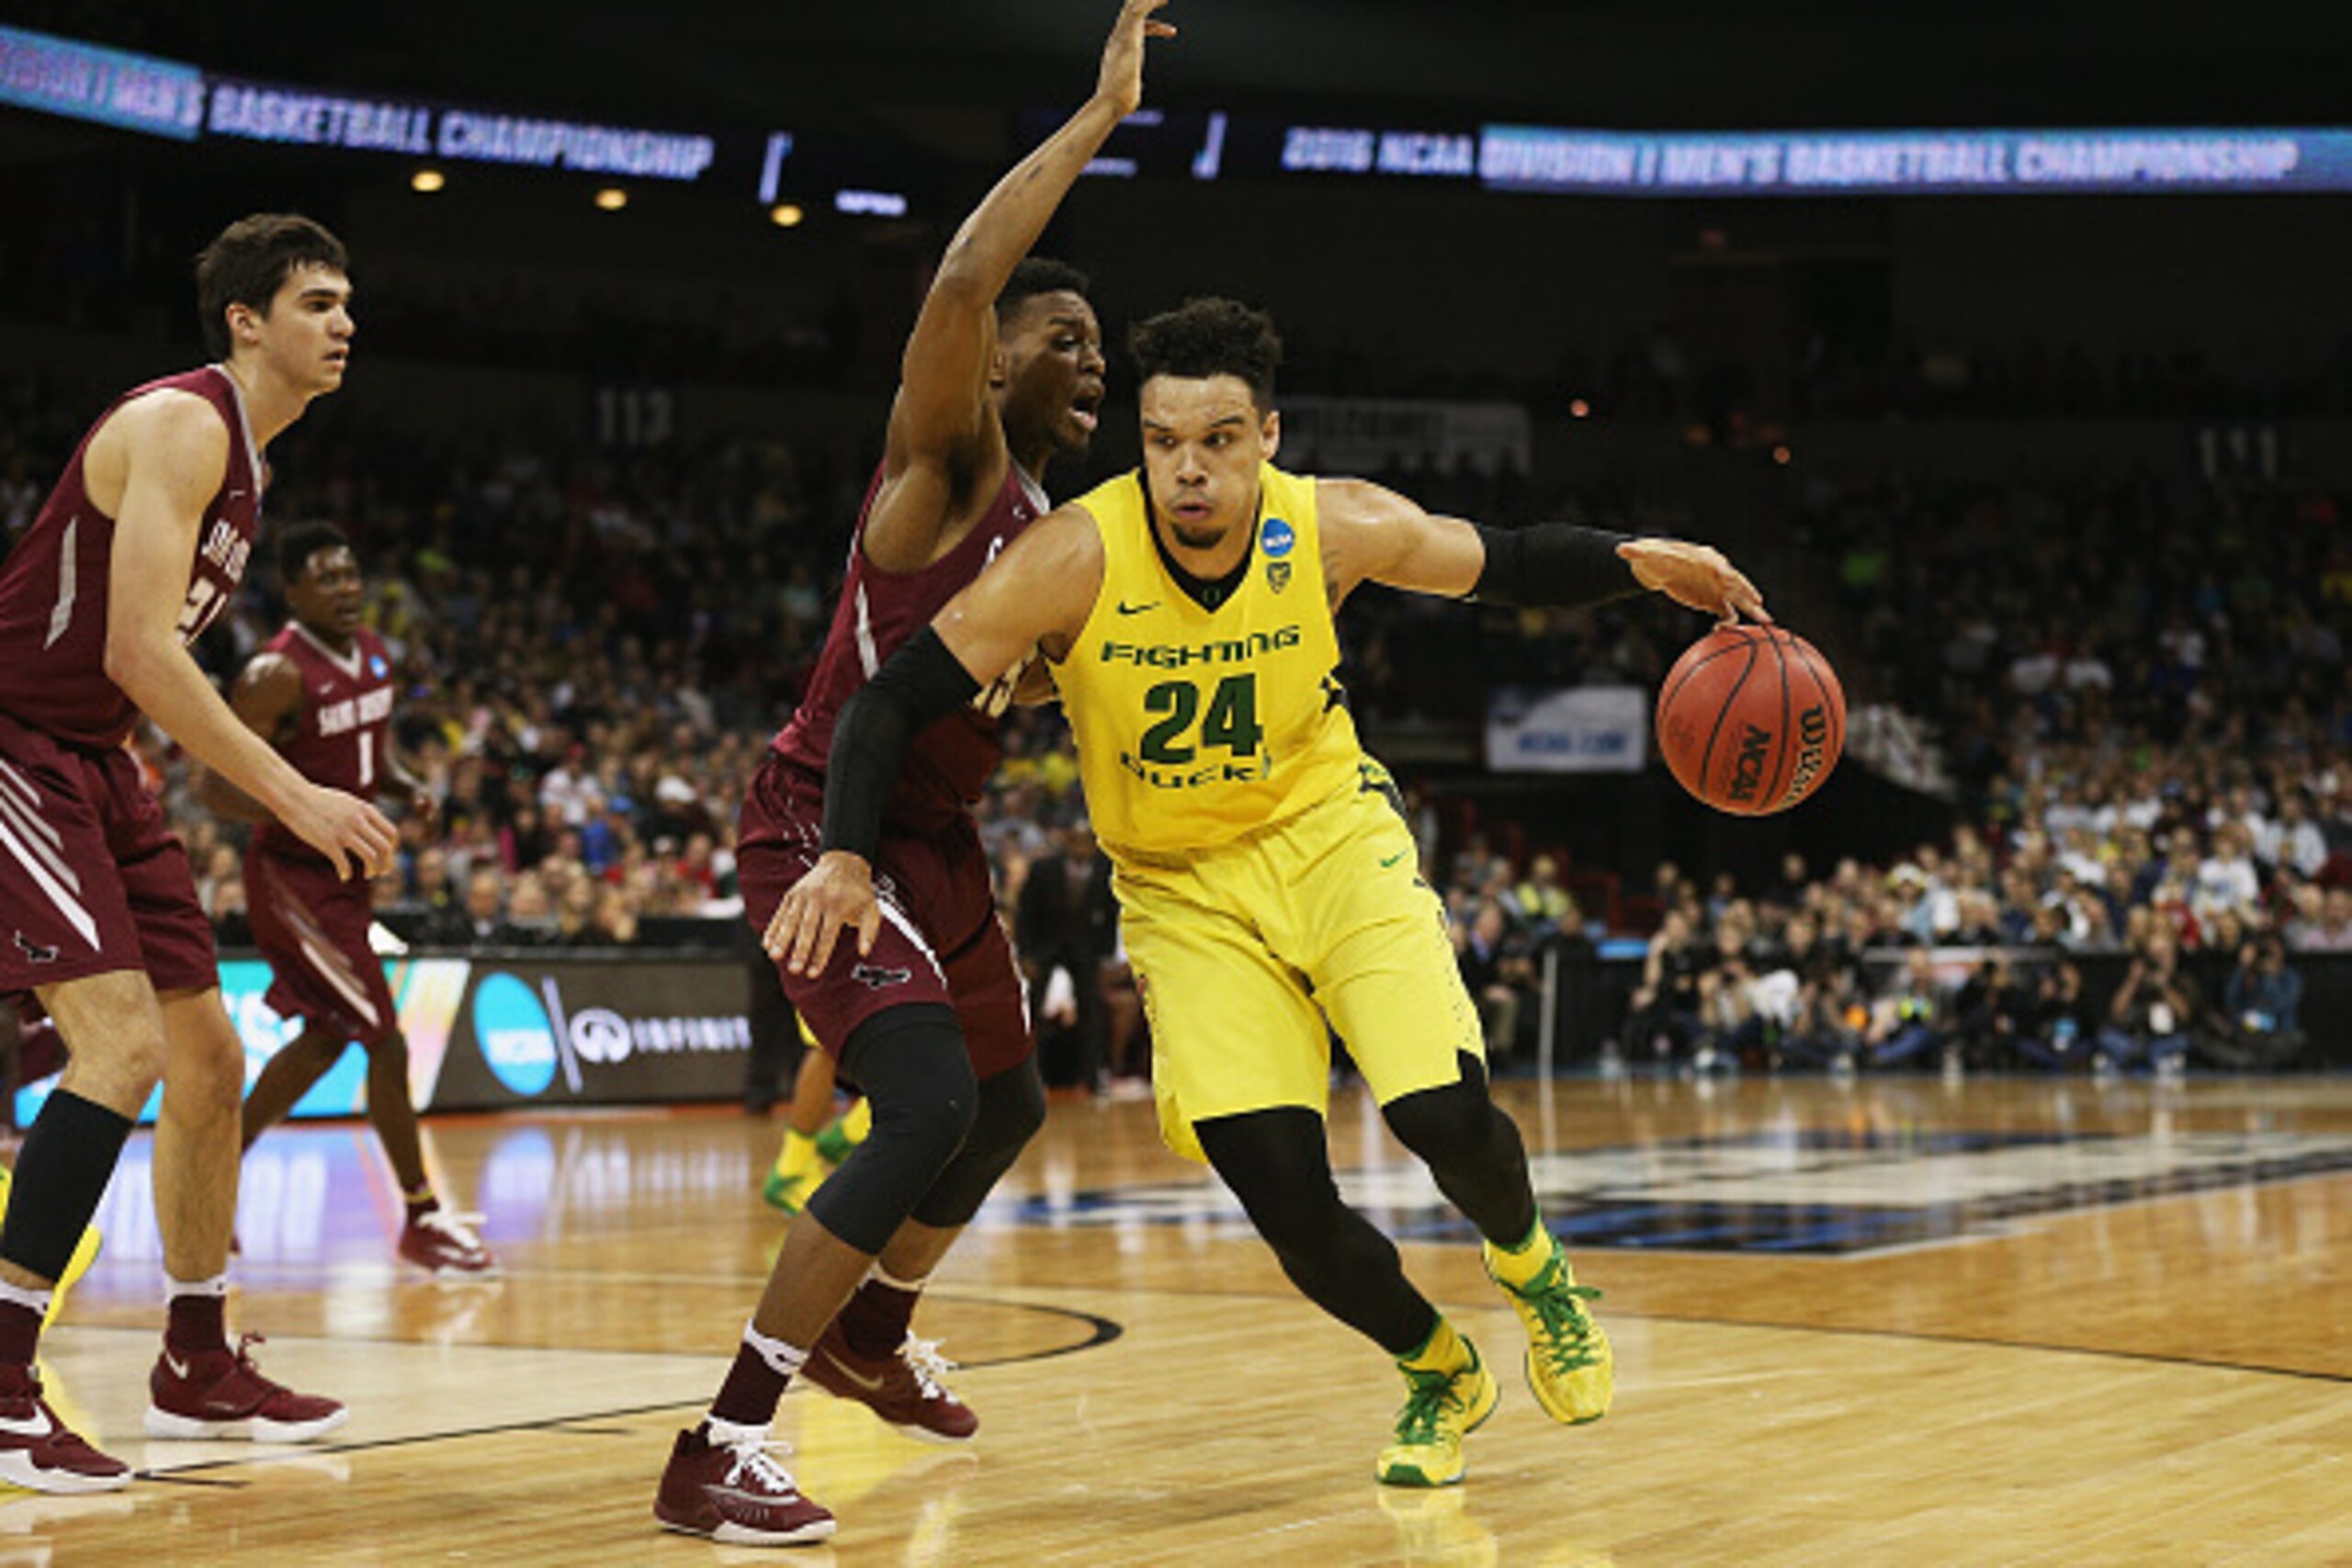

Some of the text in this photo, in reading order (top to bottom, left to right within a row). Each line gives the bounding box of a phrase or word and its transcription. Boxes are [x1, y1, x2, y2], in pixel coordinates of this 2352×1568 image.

[208, 83, 430, 154] BASKETBALL
[437, 109, 715, 181] CHAMPIONSHIP
[1377, 130, 1474, 175] NCAA
[1479, 135, 1635, 183] DIVISION
[1659, 141, 1781, 184] MEN'S
[1784, 140, 2008, 185] BASKETBALL
[2017, 138, 2298, 184] CHAMPIONSHIP
[1101, 625, 1301, 669] FIGHTING
[1139, 671, 1264, 765] 24
[357, 728, 375, 789] 1
[1726, 722, 1773, 802] NCAA
